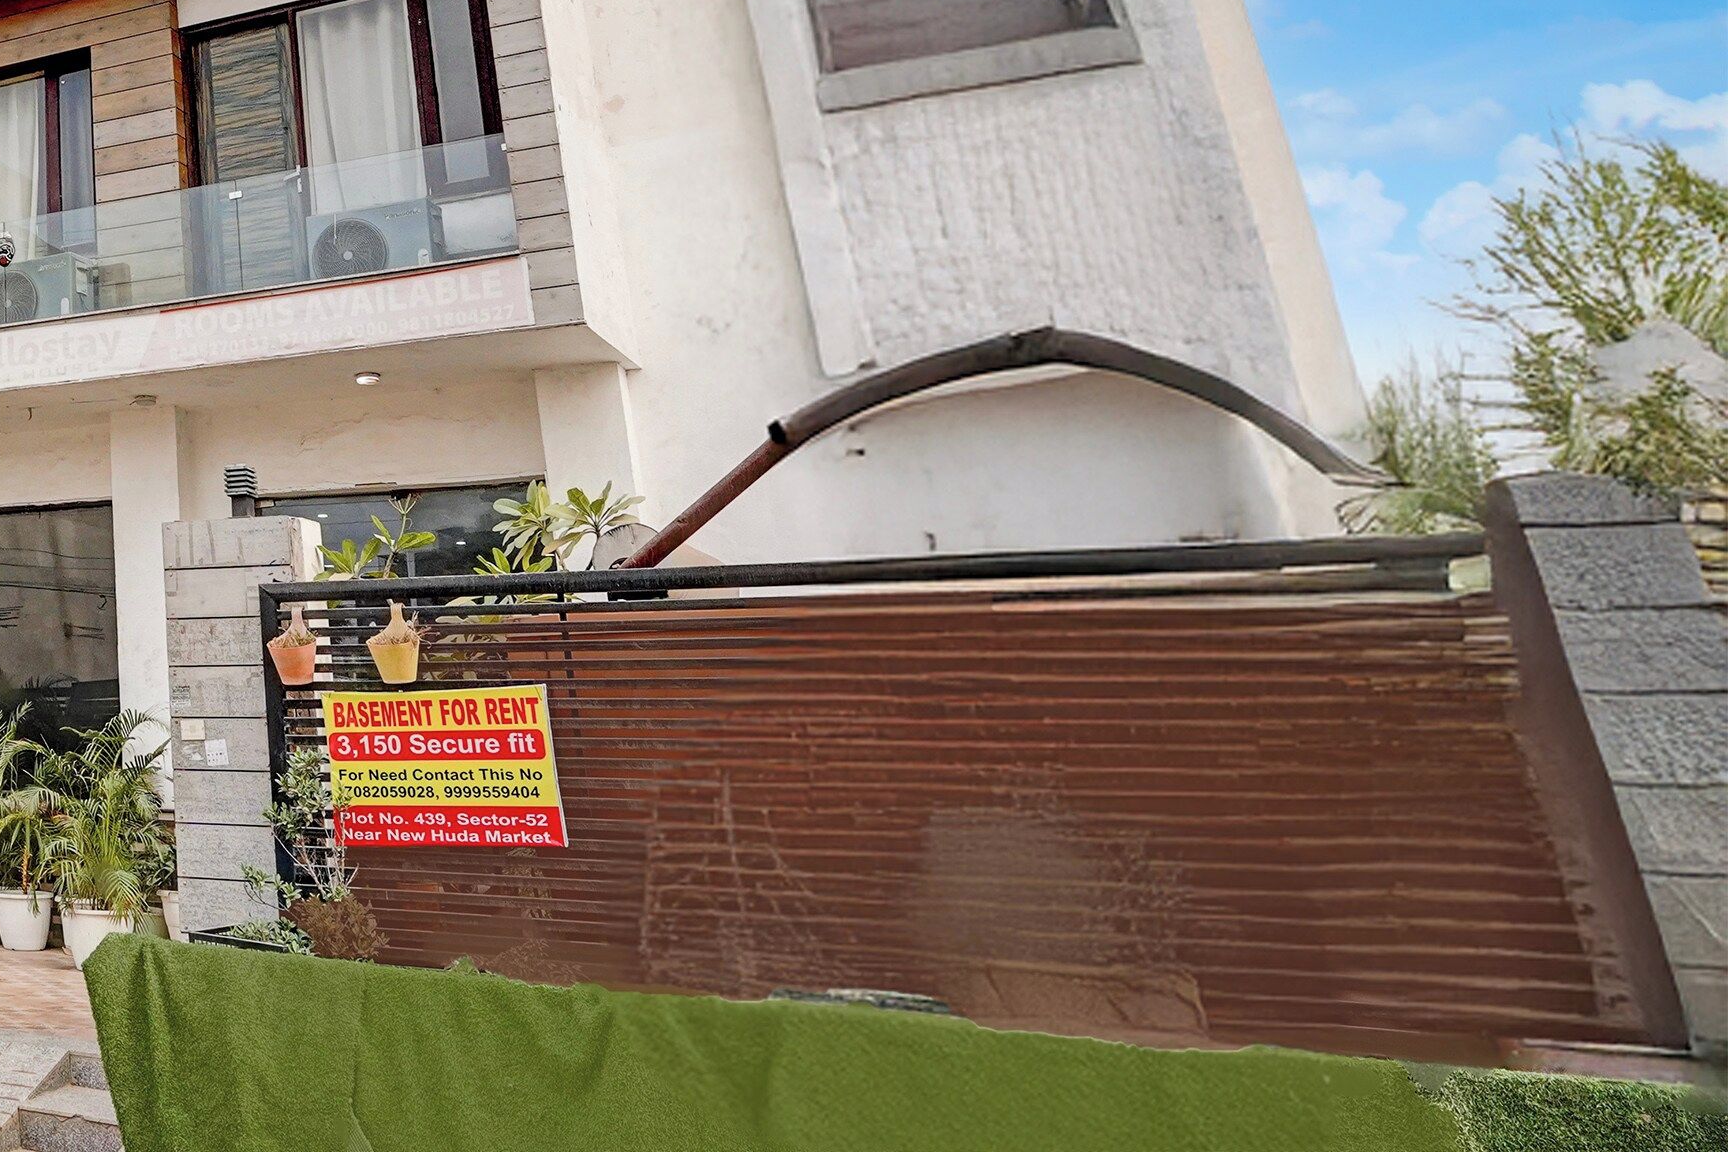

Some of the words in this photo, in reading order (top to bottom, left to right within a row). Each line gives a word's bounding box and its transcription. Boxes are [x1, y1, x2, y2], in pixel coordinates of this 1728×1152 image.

[333, 700, 433, 728] BASEMENT
[439, 699, 481, 726] FOR
[485, 697, 539, 724] RENT
[337, 735, 402, 758] 3,150
[409, 734, 500, 754] Secure
[507, 733, 537, 753] fit
[339, 769, 364, 781] For
[368, 769, 407, 781] Need
[412, 769, 474, 781] Contact
[478, 769, 515, 780] This
[519, 769, 543, 781] No
[444, 786, 540, 798] 9999559404
[339, 811, 374, 825] Plot
[379, 813, 409, 825] No.
[414, 813, 452, 827] 439,
[456, 814, 548, 826] Sector-52
[342, 828, 381, 841] Near
[387, 829, 426, 841] New
[431, 829, 480, 843] Huda
[485, 830, 552, 844] Market
